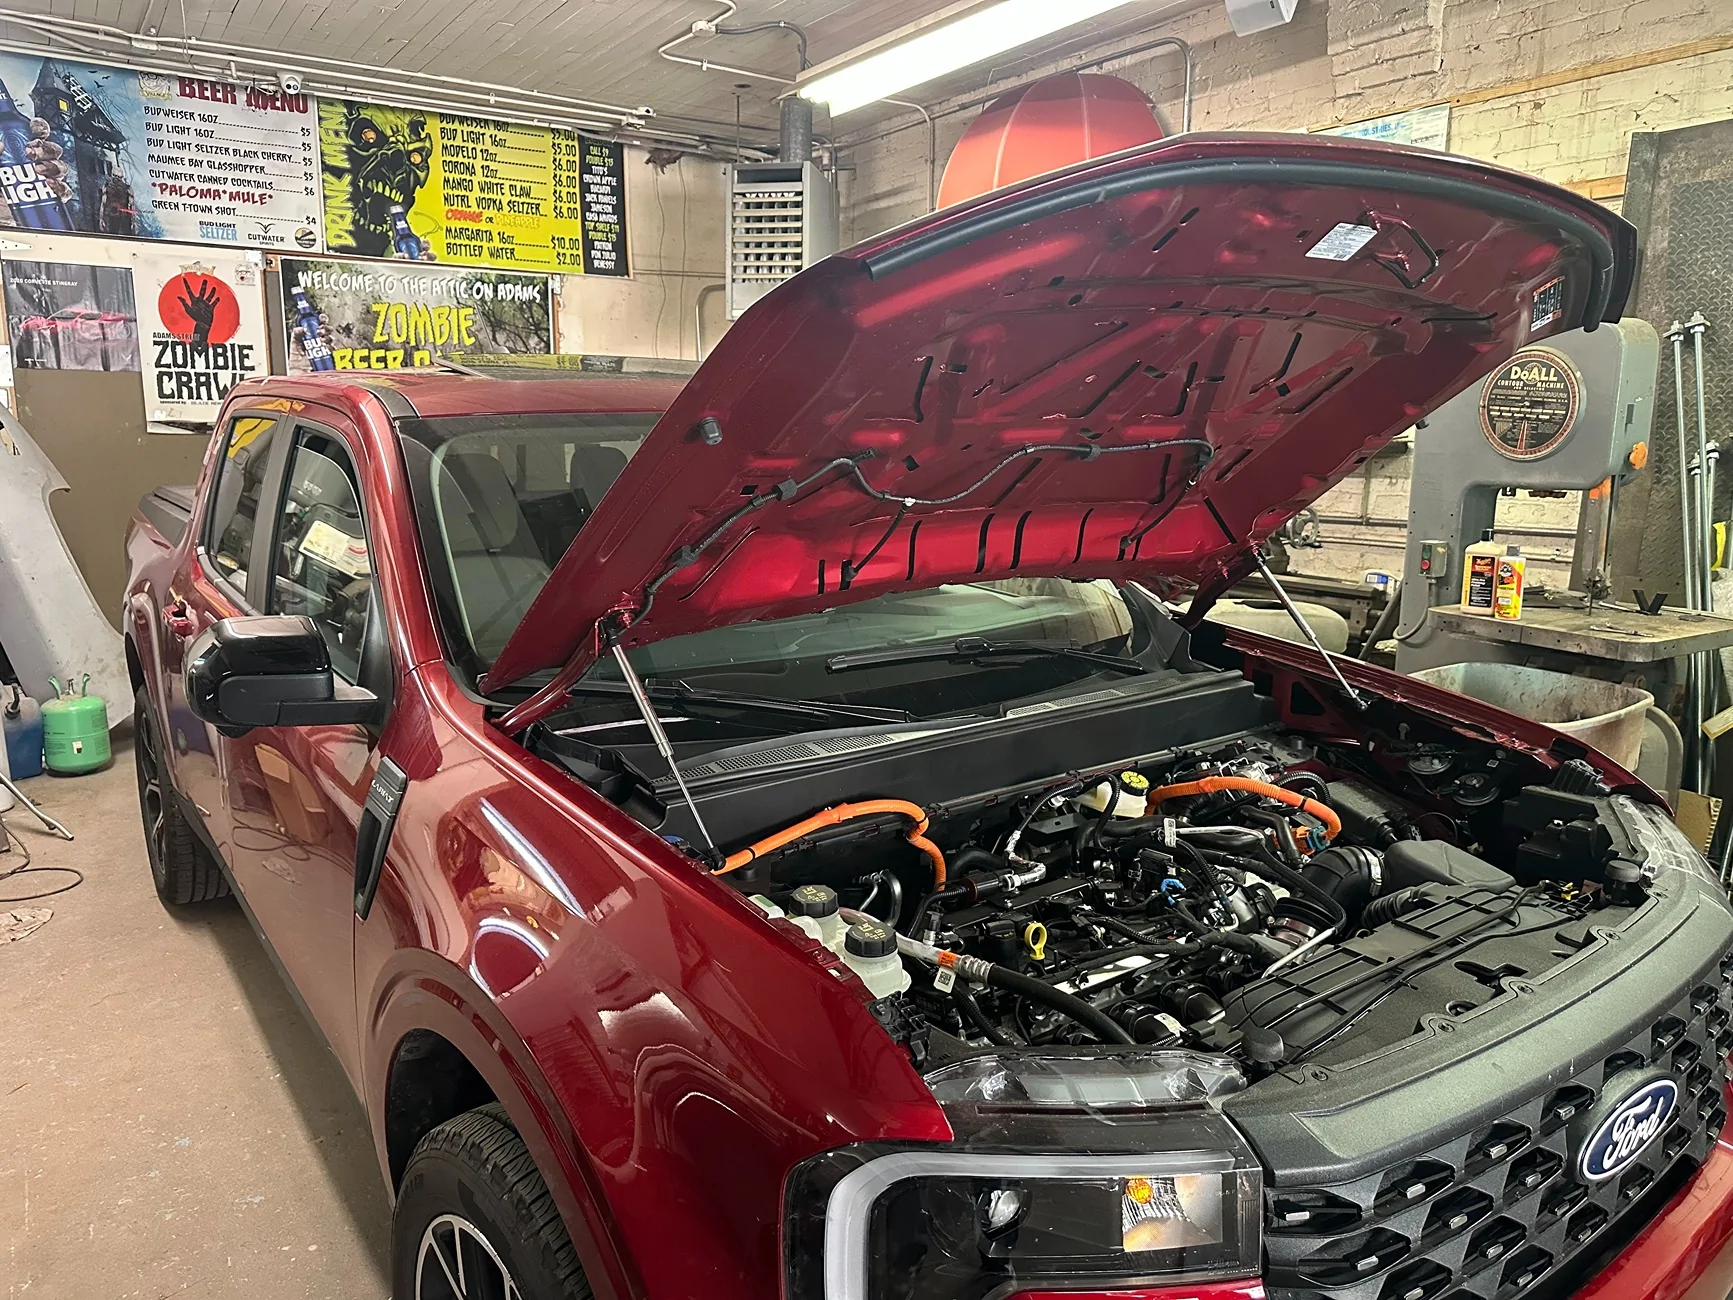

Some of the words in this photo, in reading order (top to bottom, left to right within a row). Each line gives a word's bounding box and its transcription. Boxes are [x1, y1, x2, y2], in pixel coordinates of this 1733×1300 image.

[178, 76, 237, 104] BEER
[144, 106, 196, 121] BUDWEISER
[300, 126, 311, 137] $5
[145, 122, 163, 132] BUD
[166, 124, 191, 136] LIGHT
[301, 141, 312, 152] $5
[440, 127, 458, 141] BUD
[461, 129, 486, 146] LIGHT
[551, 141, 577, 157] $5.00
[146, 137, 164, 148] BUD
[167, 140, 192, 152] LIGHT
[195, 143, 231, 157] SELTZER
[233, 148, 258, 160] BLACK
[261, 151, 293, 164] CHERRY
[302, 156, 313, 167] $5
[441, 143, 477, 160] MODELO
[551, 156, 577, 173] $6.00
[0, 163, 46, 186] BU
[147, 154, 186, 166] MAUMEE
[188, 159, 204, 169] BAY
[207, 160, 266, 175] GLASSHOPPER
[303, 171, 314, 181] $5
[442, 160, 477, 177] CORONA
[552, 172, 577, 189] $6.00
[1, 178, 57, 204] LIGH
[149, 169, 195, 183] CUTWATER
[197, 174, 228, 186] CANNED
[231, 178, 274, 191] COCKTAILS
[304, 186, 315, 197] $6
[443, 176, 474, 193] MANGO
[478, 181, 505, 196] WHITE
[509, 184, 531, 199] CLAW
[552, 188, 577, 204] $6.00
[151, 200, 179, 211] GREEN
[182, 203, 213, 215] T-TOWN
[215, 206, 237, 216] SHOT
[305, 215, 317, 226] $4
[323, 171, 357, 248] DRINK
[443, 192, 472, 208] NUTRL
[475, 196, 504, 213] VODKA
[507, 199, 541, 217] SELTZER
[553, 203, 579, 220] $6.00
[200, 227, 238, 241] SELTZER
[215, 221, 237, 229] LIGHT
[494, 214, 541, 229] PINEAPPLE
[247, 233, 285, 243] CUTWATER
[445, 225, 494, 243] MARGARITA
[551, 234, 580, 251] $10.00
[446, 242, 483, 258] BOTTLED
[487, 246, 517, 261] WATER
[556, 251, 581, 266] $2.00
[298, 270, 374, 293] WELCOME
[378, 274, 397, 294] TO
[401, 276, 428, 297] THE
[432, 277, 469, 298] ATTIC
[472, 281, 494, 301] ON
[497, 283, 541, 303] ADAMS
[372, 301, 476, 347] ZOMBIE
[152, 340, 256, 371] ZOMBIE
[303, 337, 322, 350] BU
[156, 371, 245, 400] CRAW
[1510, 366, 1558, 382] DoALL
[1536, 381, 1564, 389] MACHINE
[371, 779, 394, 804] LARIAT
[1603, 1096, 1664, 1170] Ford
